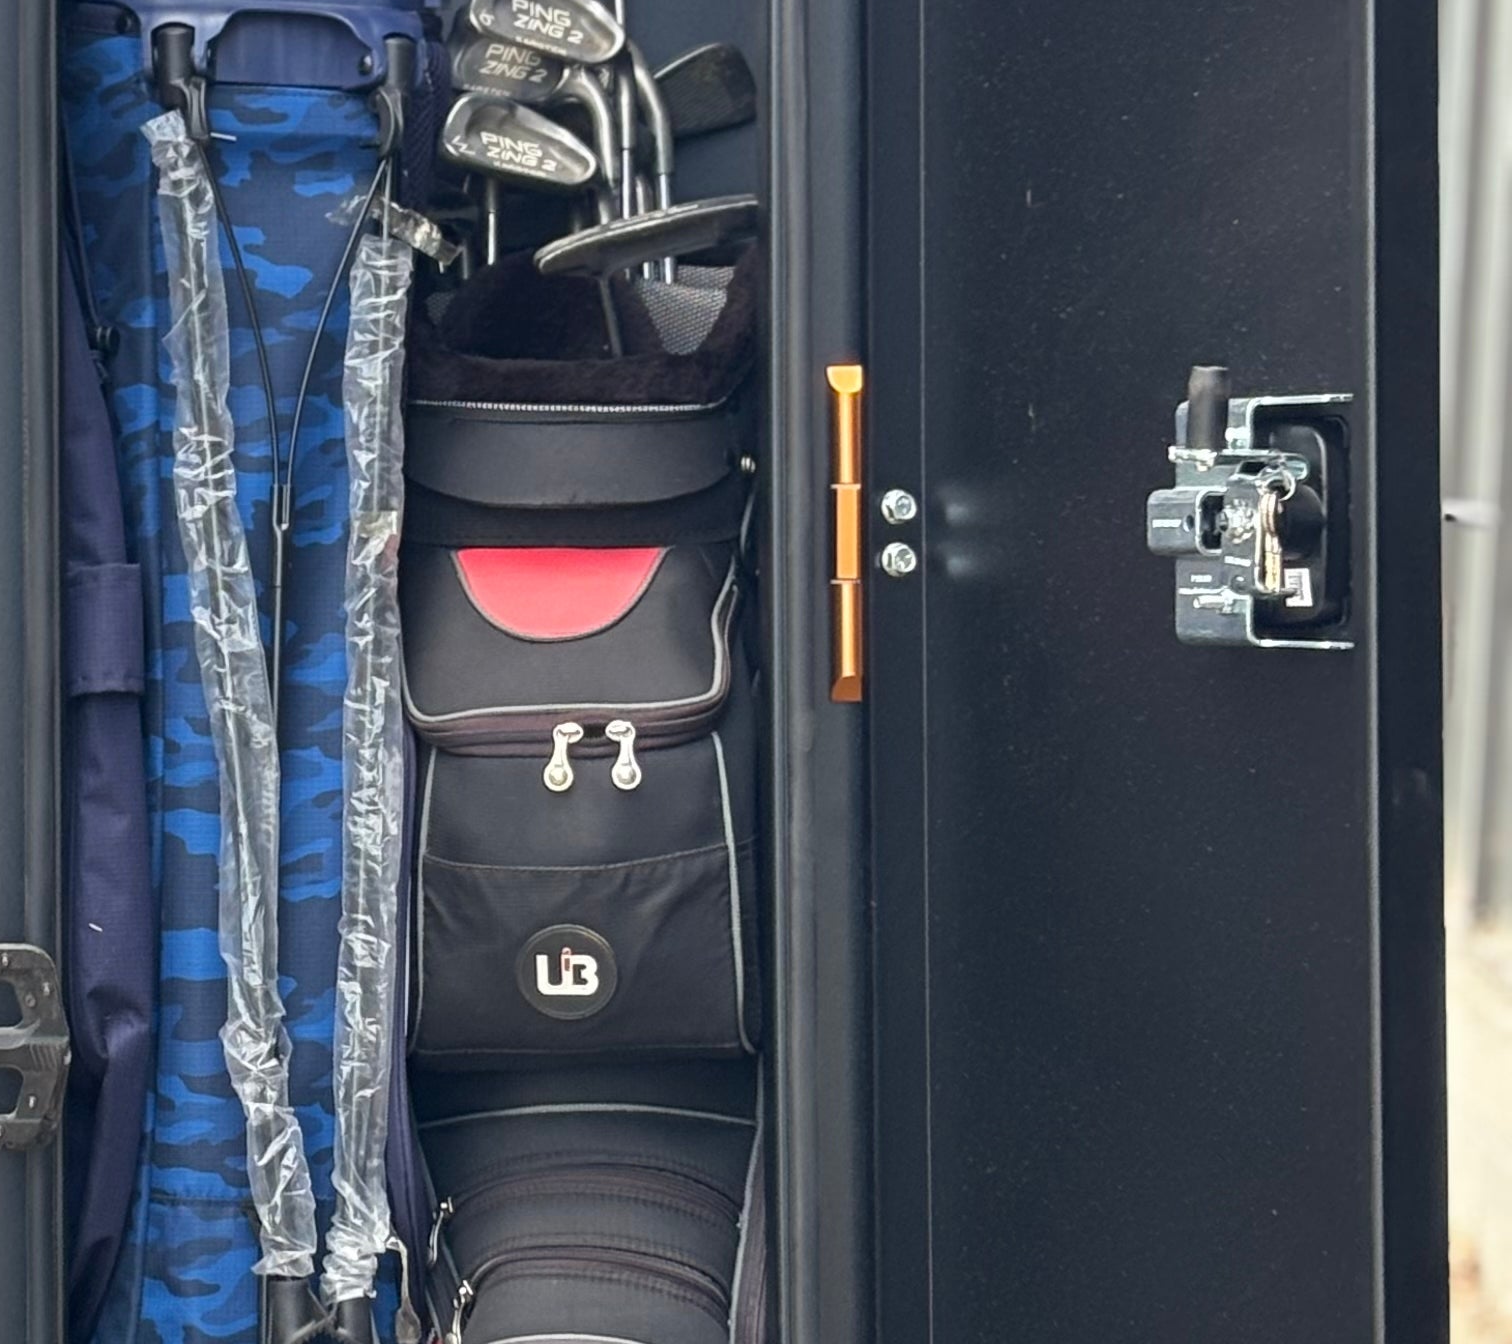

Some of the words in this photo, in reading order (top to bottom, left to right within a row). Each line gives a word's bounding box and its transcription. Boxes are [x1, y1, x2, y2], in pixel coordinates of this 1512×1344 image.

[513, 13, 566, 39] ZING
[567, 30, 584, 45] 2
[485, 43, 542, 67] PING
[479, 59, 532, 81] ZING
[528, 68, 548, 84] 2
[479, 131, 544, 158] PING
[486, 145, 539, 167] ZING
[541, 159, 558, 172] 2
